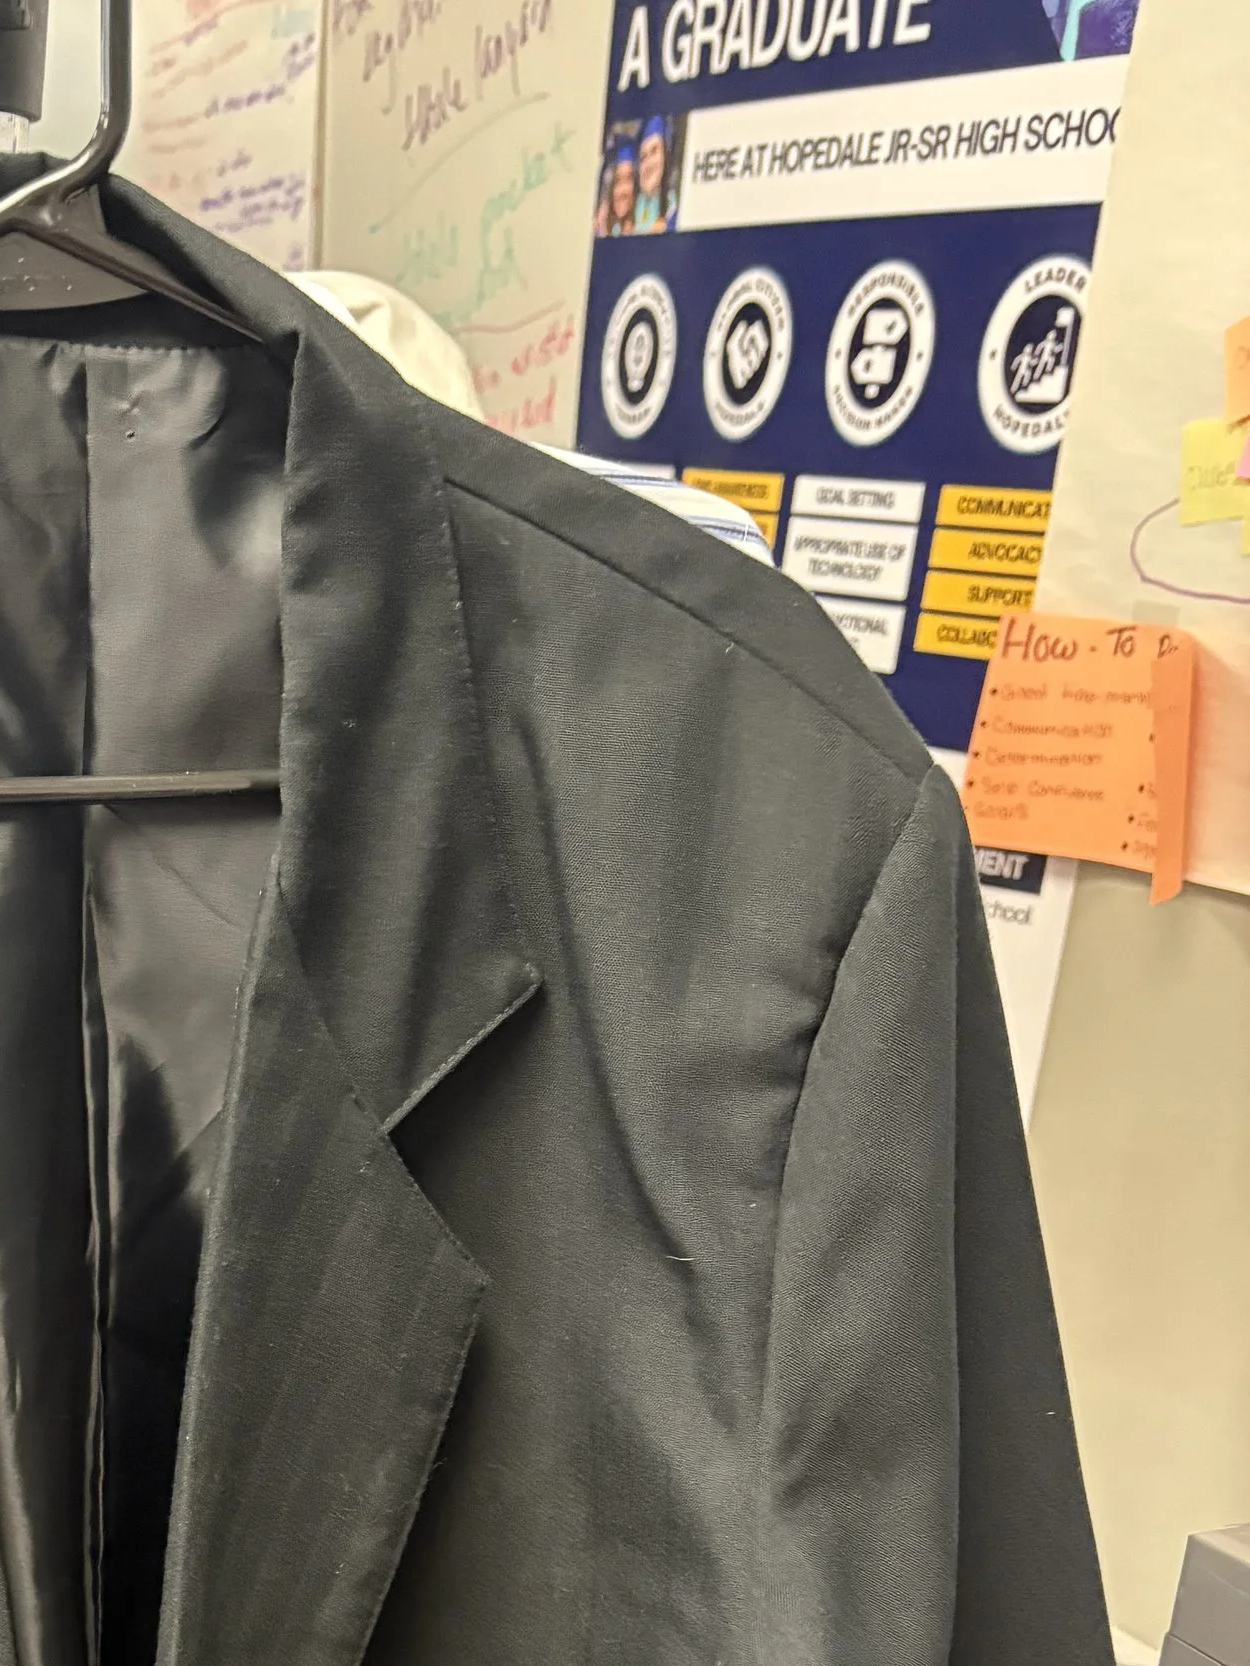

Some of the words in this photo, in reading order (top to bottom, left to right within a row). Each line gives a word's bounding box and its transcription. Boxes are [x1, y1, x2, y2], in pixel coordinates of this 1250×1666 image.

[617, 5, 650, 92] A
[661, 0, 932, 83] GRADUATE
[693, 148, 741, 182] HERE
[743, 146, 767, 177] AT
[767, 130, 884, 176] HOPEDALE
[884, 124, 950, 164] JR-SR
[953, 115, 1021, 158] HIGH
[1024, 266, 1088, 294] LEADER
[1002, 616, 1079, 662] How
[1106, 625, 1138, 658] To
